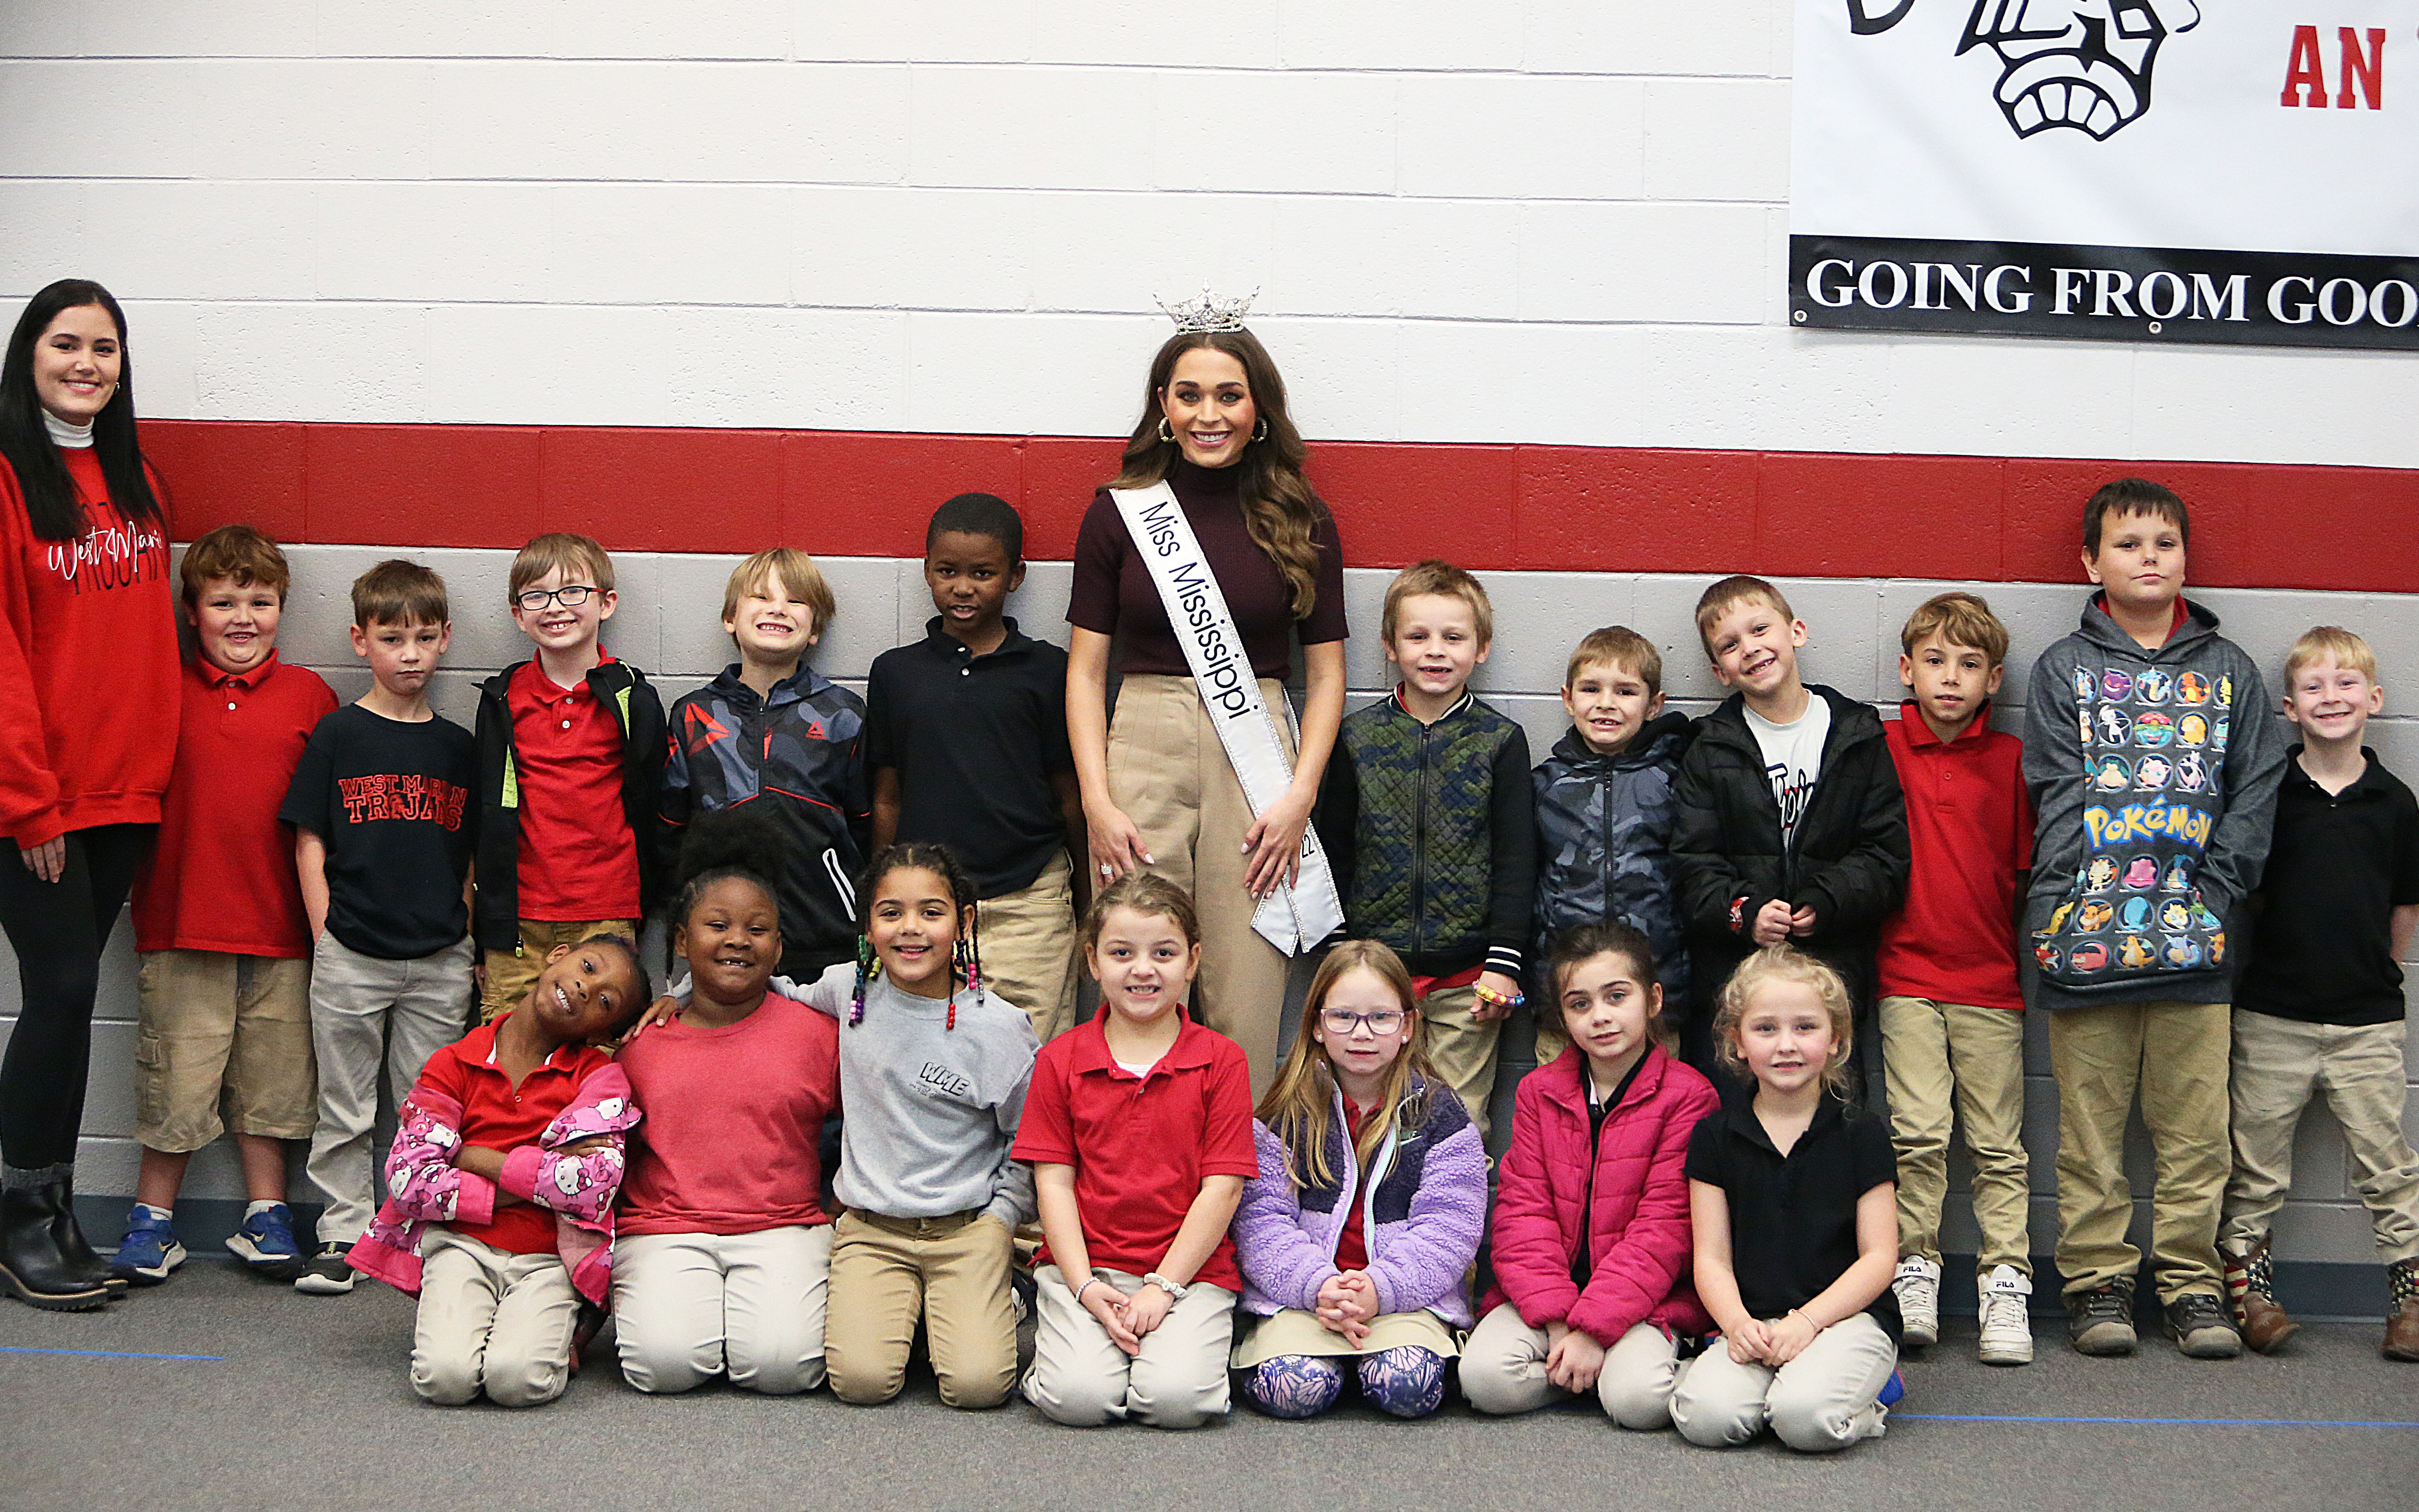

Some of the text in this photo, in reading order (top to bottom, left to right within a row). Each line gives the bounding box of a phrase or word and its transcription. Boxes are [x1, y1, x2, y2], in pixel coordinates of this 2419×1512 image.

[2281, 25, 2386, 110] AN
[1807, 259, 2419, 327] GOING FROM GOO
[48, 526, 109, 580] West
[1139, 501, 1258, 719] Miss Mississippi
[338, 774, 399, 798] WEST
[919, 1062, 971, 1097] WME
